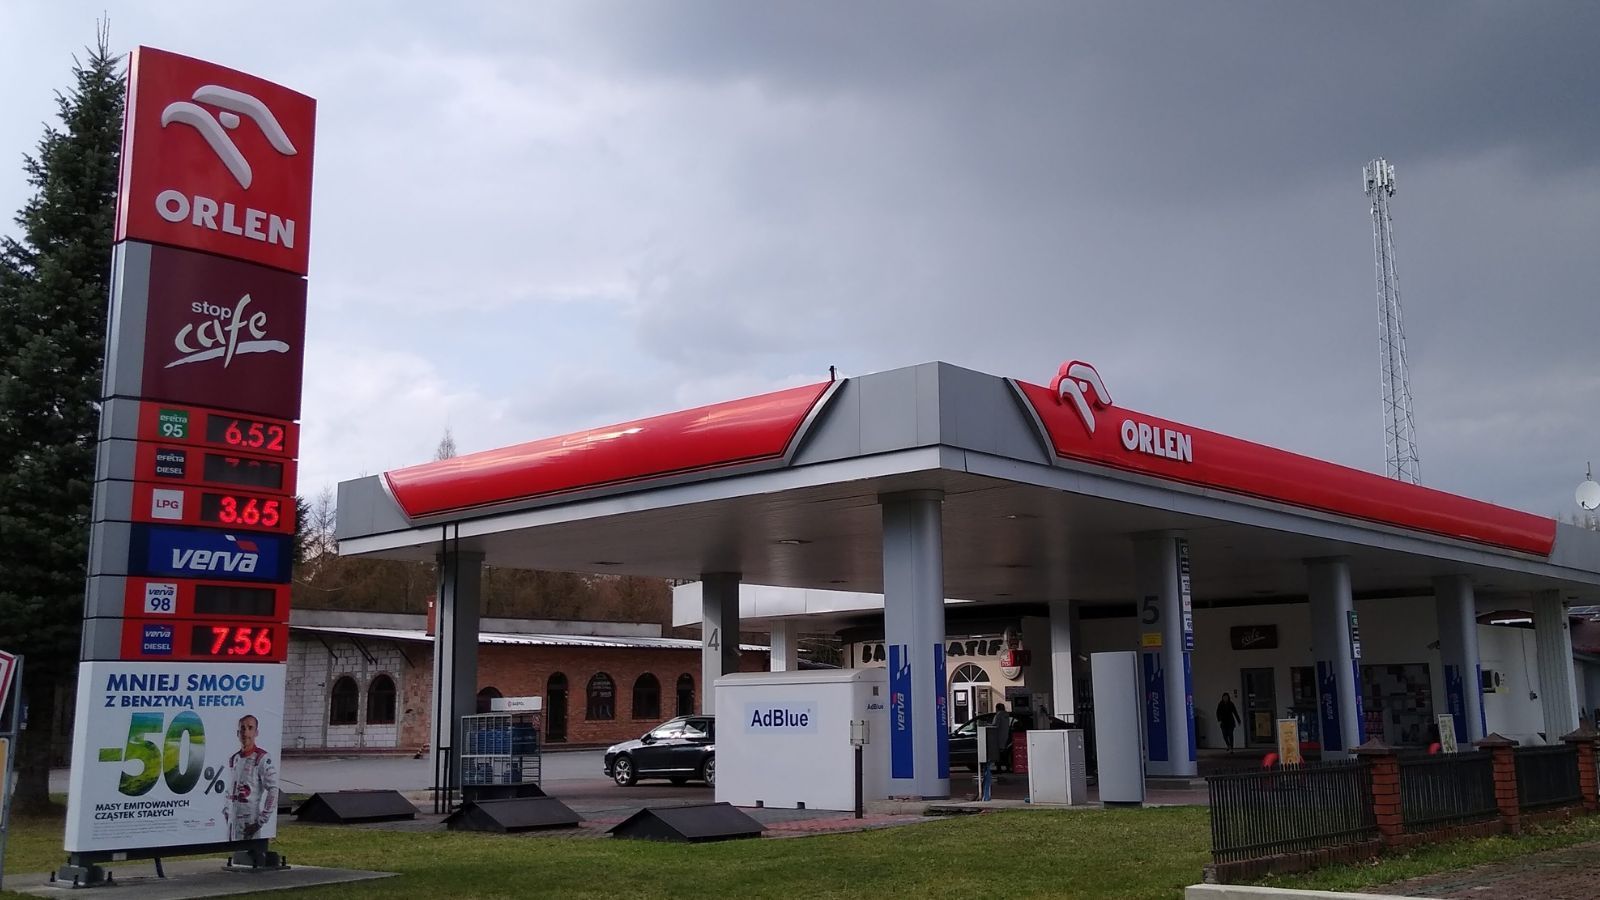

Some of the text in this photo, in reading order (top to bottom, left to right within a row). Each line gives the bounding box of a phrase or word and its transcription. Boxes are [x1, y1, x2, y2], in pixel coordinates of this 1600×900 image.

[154, 189, 296, 249] ORLEN
[191, 300, 232, 321] stop
[173, 294, 271, 369] cafe
[162, 423, 183, 438] 95
[225, 420, 284, 451] 6.52
[1121, 419, 1193, 463] ORLEN
[156, 466, 184, 475] DIESEL
[156, 498, 179, 510] LPG
[218, 496, 279, 526] 3.65
[172, 547, 259, 573] verva
[148, 587, 174, 597] verva
[150, 596, 171, 612] 98
[1142, 595, 1160, 625] 5
[144, 629, 171, 638] verva
[210, 627, 272, 655] 7.56
[707, 627, 720, 652] 4
[144, 642, 171, 651] DIESEL
[945, 638, 1004, 657] ATIF
[106, 673, 265, 692] MNIEJ SMOGU
[104, 694, 245, 710] Z BENZYNĄ EFECTA
[866, 703, 884, 711] AdBlue
[897, 691, 905, 731] verva
[751, 708, 809, 729] AdBlue
[94, 808, 174, 822] CZĄSTEK STAŁYCH
[95, 799, 190, 812] MASY EMITOWANYCH
